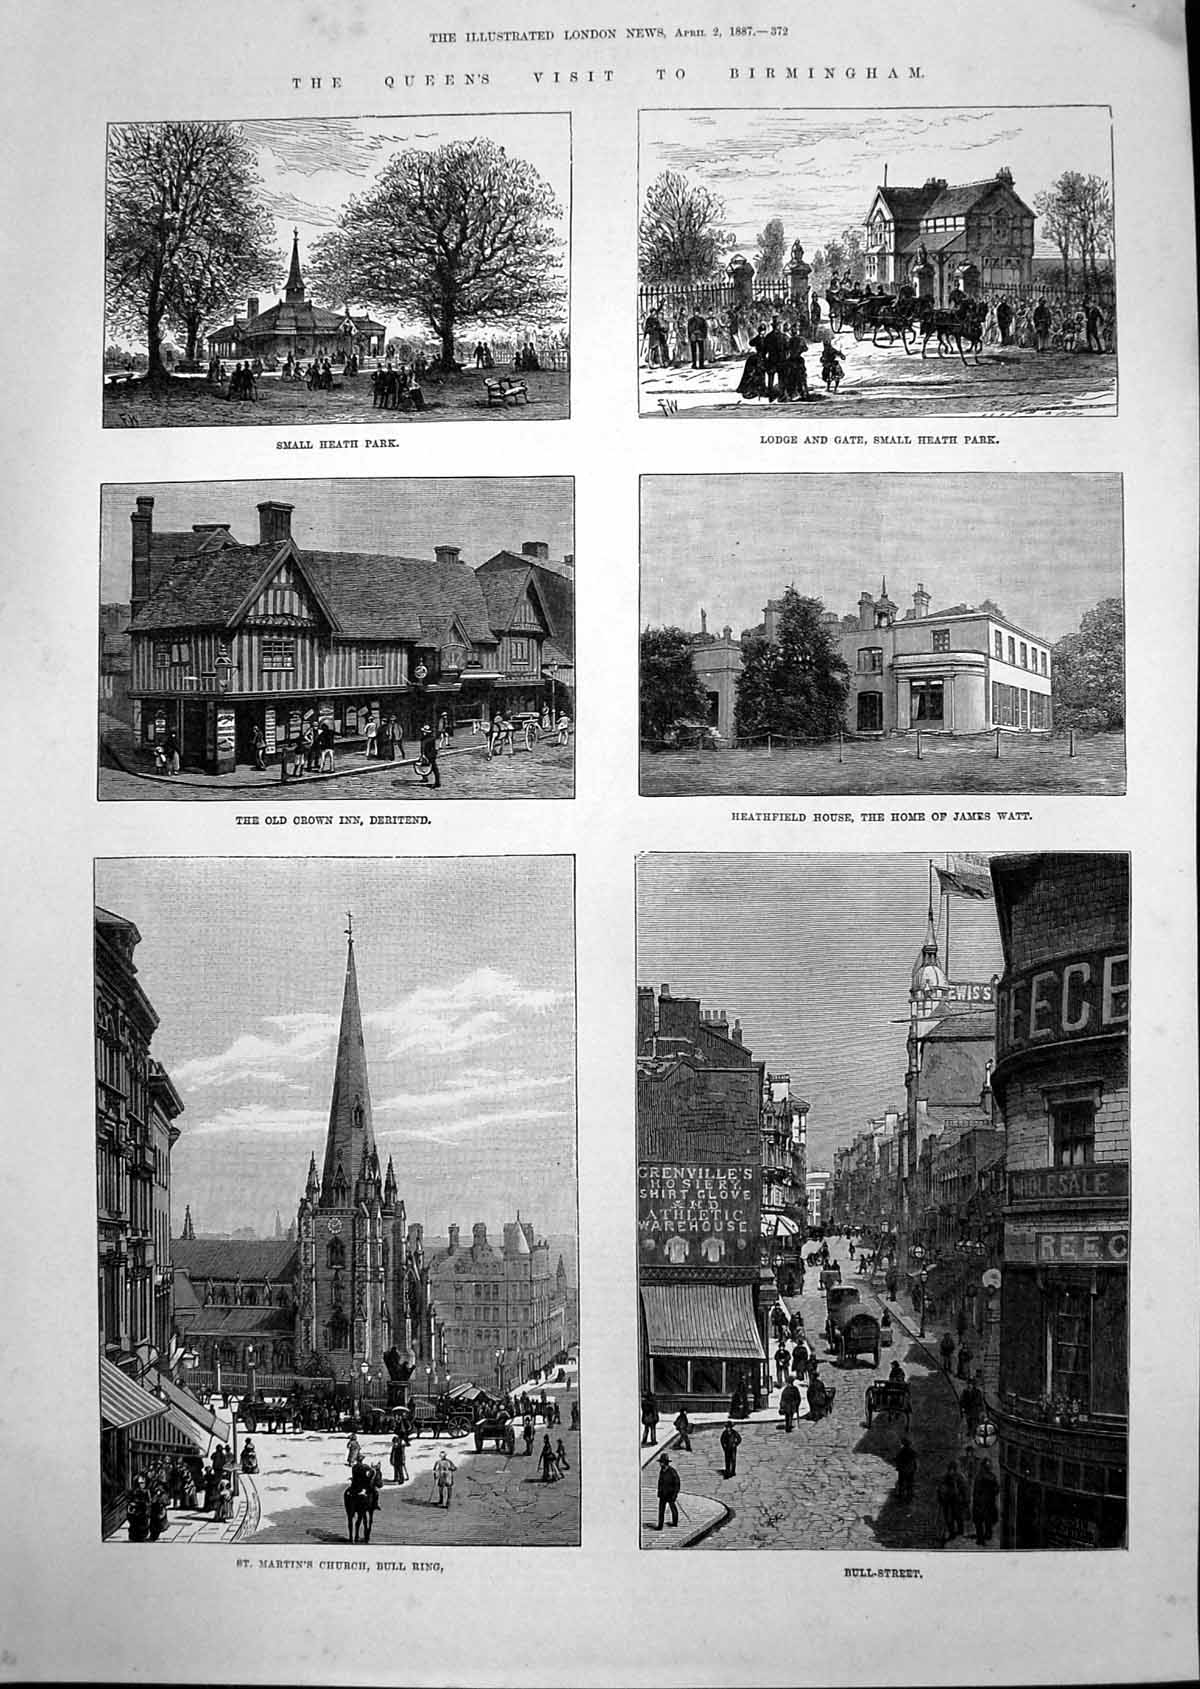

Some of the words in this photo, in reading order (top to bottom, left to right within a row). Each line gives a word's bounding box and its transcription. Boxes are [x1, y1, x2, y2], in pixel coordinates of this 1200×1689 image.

[429, 32, 457, 44] THE
[465, 31, 555, 43] ILLUSTRATED
[564, 29, 617, 41] LONDON
[626, 28, 667, 40] NEWS,
[713, 27, 723, 39] 2,
[292, 77, 342, 90] THE
[384, 73, 490, 90] QUEEN'S
[533, 70, 614, 84] VISIT
[655, 69, 686, 81] TO
[729, 66, 925, 80] BIRMINGHAM.
[276, 439, 314, 451] SMALL
[319, 439, 359, 450] HEATH
[364, 438, 400, 449] PARK.
[759, 435, 799, 445] LODGE
[803, 435, 829, 445] AND
[834, 435, 868, 446] GATE,
[873, 434, 913, 445] SMALL
[916, 434, 959, 445] HEATH
[963, 434, 1000, 445] PARK.
[235, 815, 261, 826] THE
[264, 815, 288, 826] OLD
[293, 815, 334, 826] CROWN
[338, 815, 364, 827] INN,
[369, 815, 432, 826] DERITEND.
[731, 811, 807, 823] HEATHFIELD
[812, 812, 855, 824] HOUSE,
[860, 812, 886, 823] THE
[891, 811, 926, 822] HOME
[930, 811, 948, 822] OF
[952, 811, 992, 822] JAMES
[997, 811, 1033, 821] WATT.
[638, 1167, 753, 1180] GRENVILLE'S
[640, 1189, 689, 1200] SHIRT
[697, 1190, 751, 1200] GLOVE
[645, 1209, 744, 1221] ATHLETIC
[235, 1558, 254, 1569] ST.
[258, 1559, 314, 1570] MARTIN'S
[318, 1560, 371, 1573] CHURCH,
[375, 1561, 407, 1572] BULL
